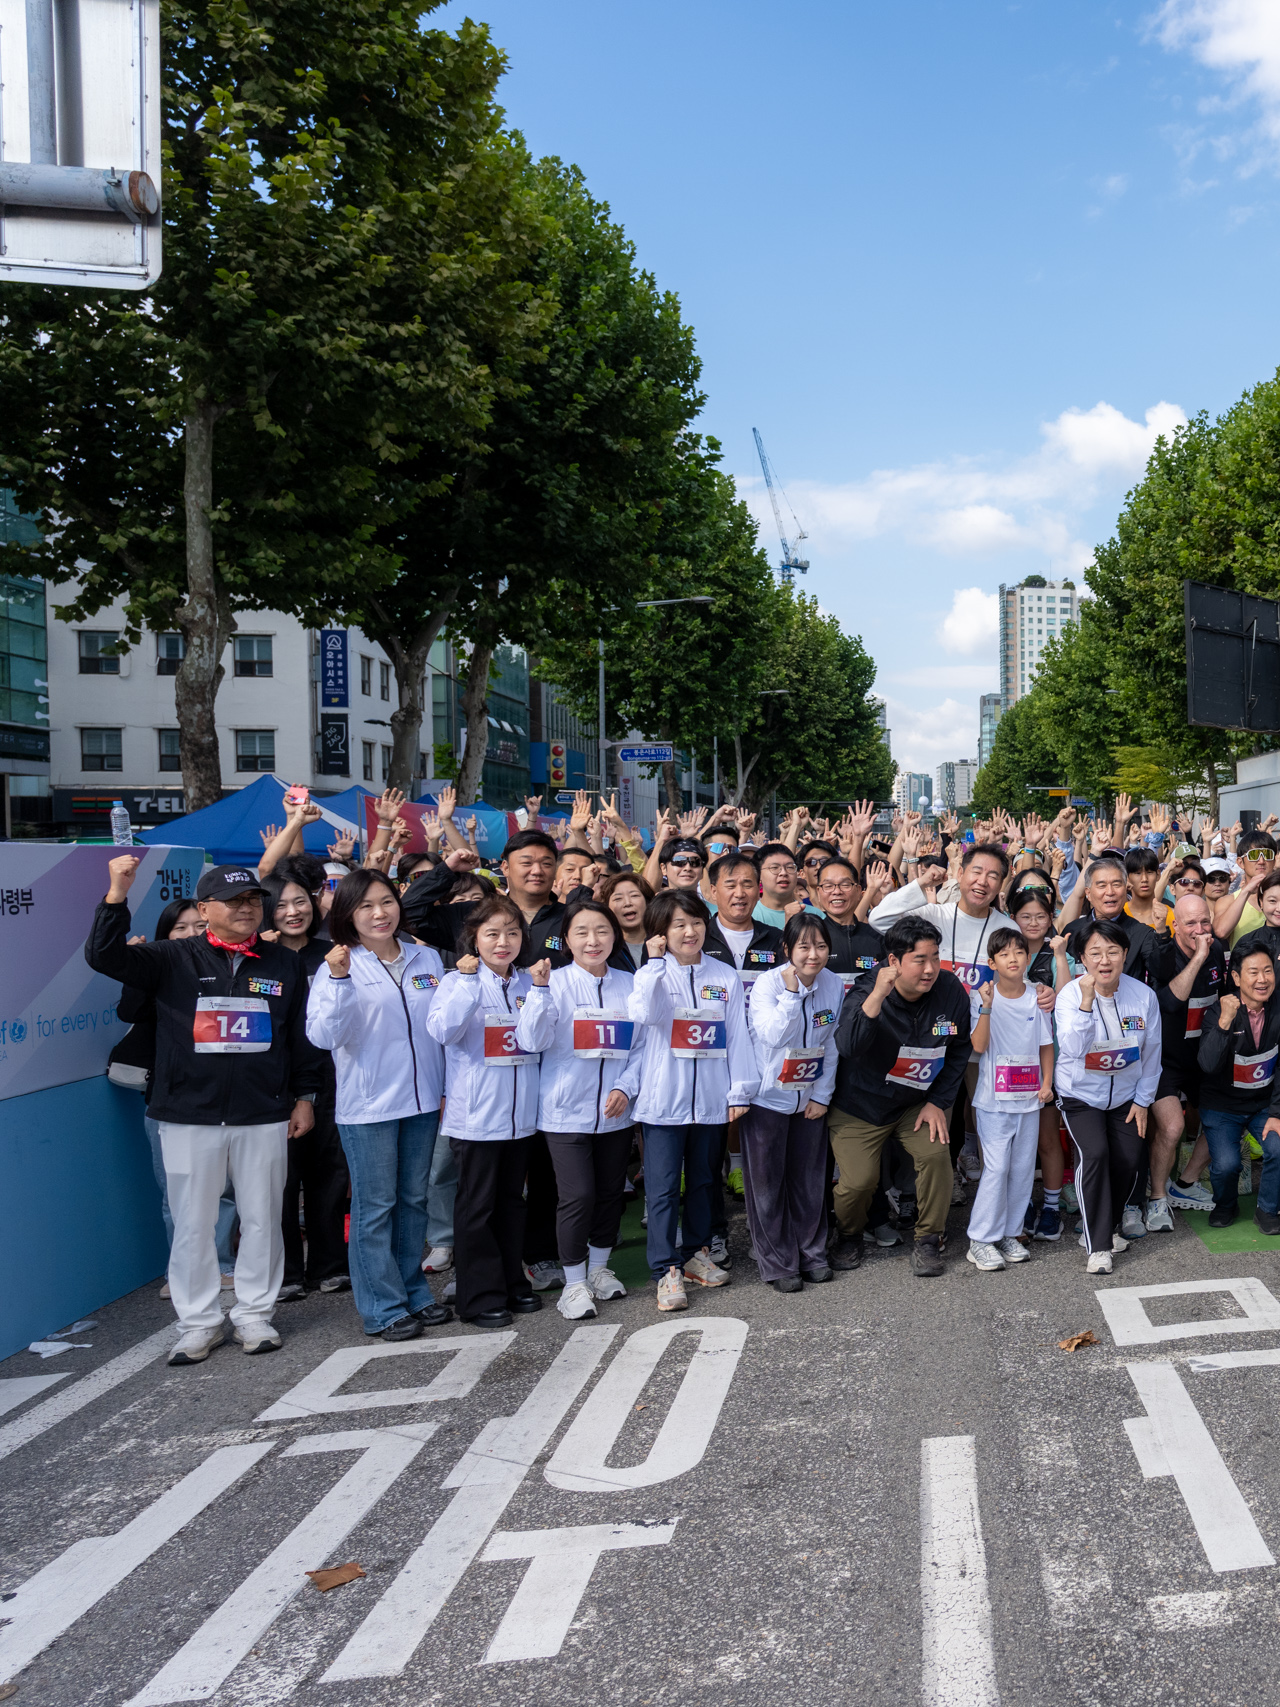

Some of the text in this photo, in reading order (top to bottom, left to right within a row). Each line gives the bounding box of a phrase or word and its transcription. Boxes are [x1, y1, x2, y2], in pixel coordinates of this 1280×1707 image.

[326, 651, 335, 687] 오아시스
[325, 726, 337, 739] ZIG
[326, 733, 342, 748] ZAG
[633, 748, 671, 756] 봉은사로112길
[1182, 845, 1191, 854] B
[156, 869, 183, 902] 강남
[954, 966, 981, 987] 40
[36, 1014, 56, 1038] for
[61, 1011, 98, 1034] every
[217, 1015, 250, 1038] 14
[503, 1030, 521, 1052] 3
[595, 1025, 616, 1045] 11
[687, 1024, 716, 1045] 34
[1099, 1053, 1126, 1069] 36
[793, 1062, 819, 1080] 32
[905, 1062, 932, 1080] 26
[996, 1074, 1006, 1084] A
[1253, 1065, 1265, 1079] 6
